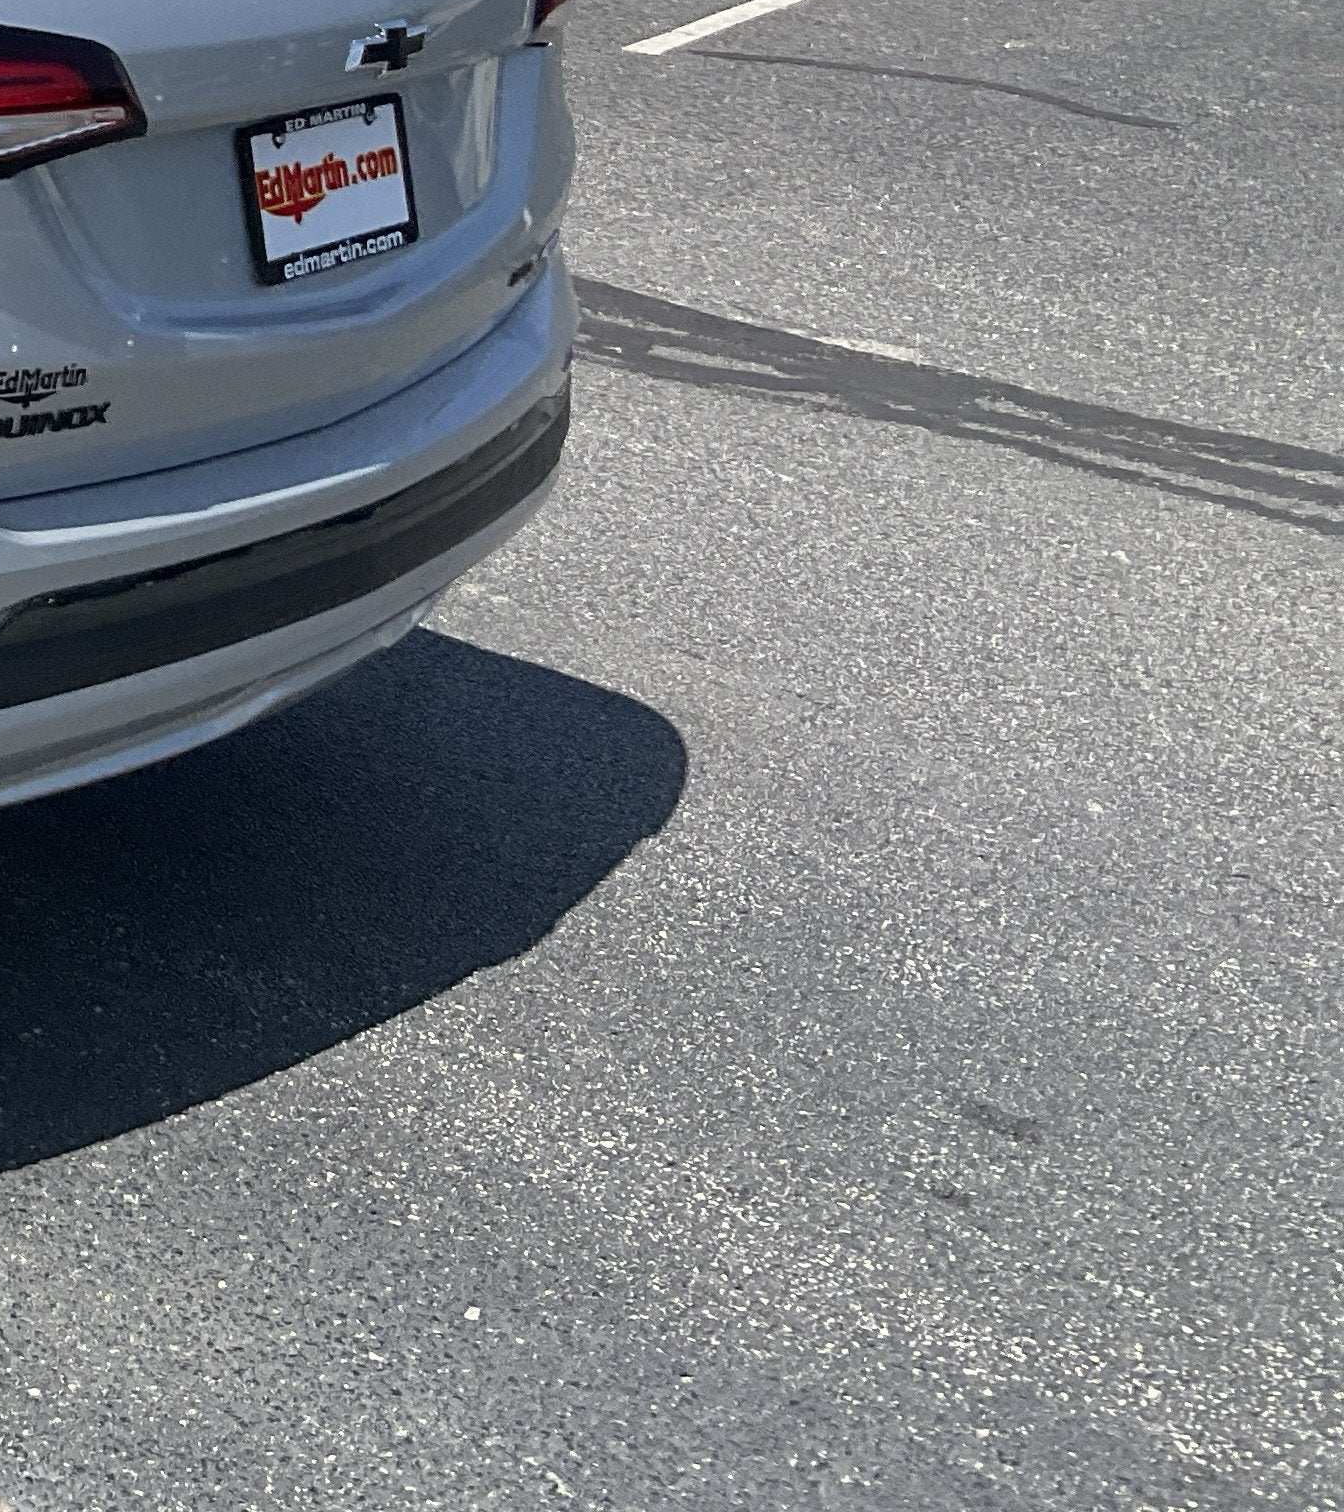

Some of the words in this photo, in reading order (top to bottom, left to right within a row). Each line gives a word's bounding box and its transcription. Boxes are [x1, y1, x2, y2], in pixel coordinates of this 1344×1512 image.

[285, 117, 308, 133] ED
[309, 102, 367, 127] MARTIN
[255, 146, 398, 212] EdMartin.com
[283, 230, 404, 279] edmartin.com
